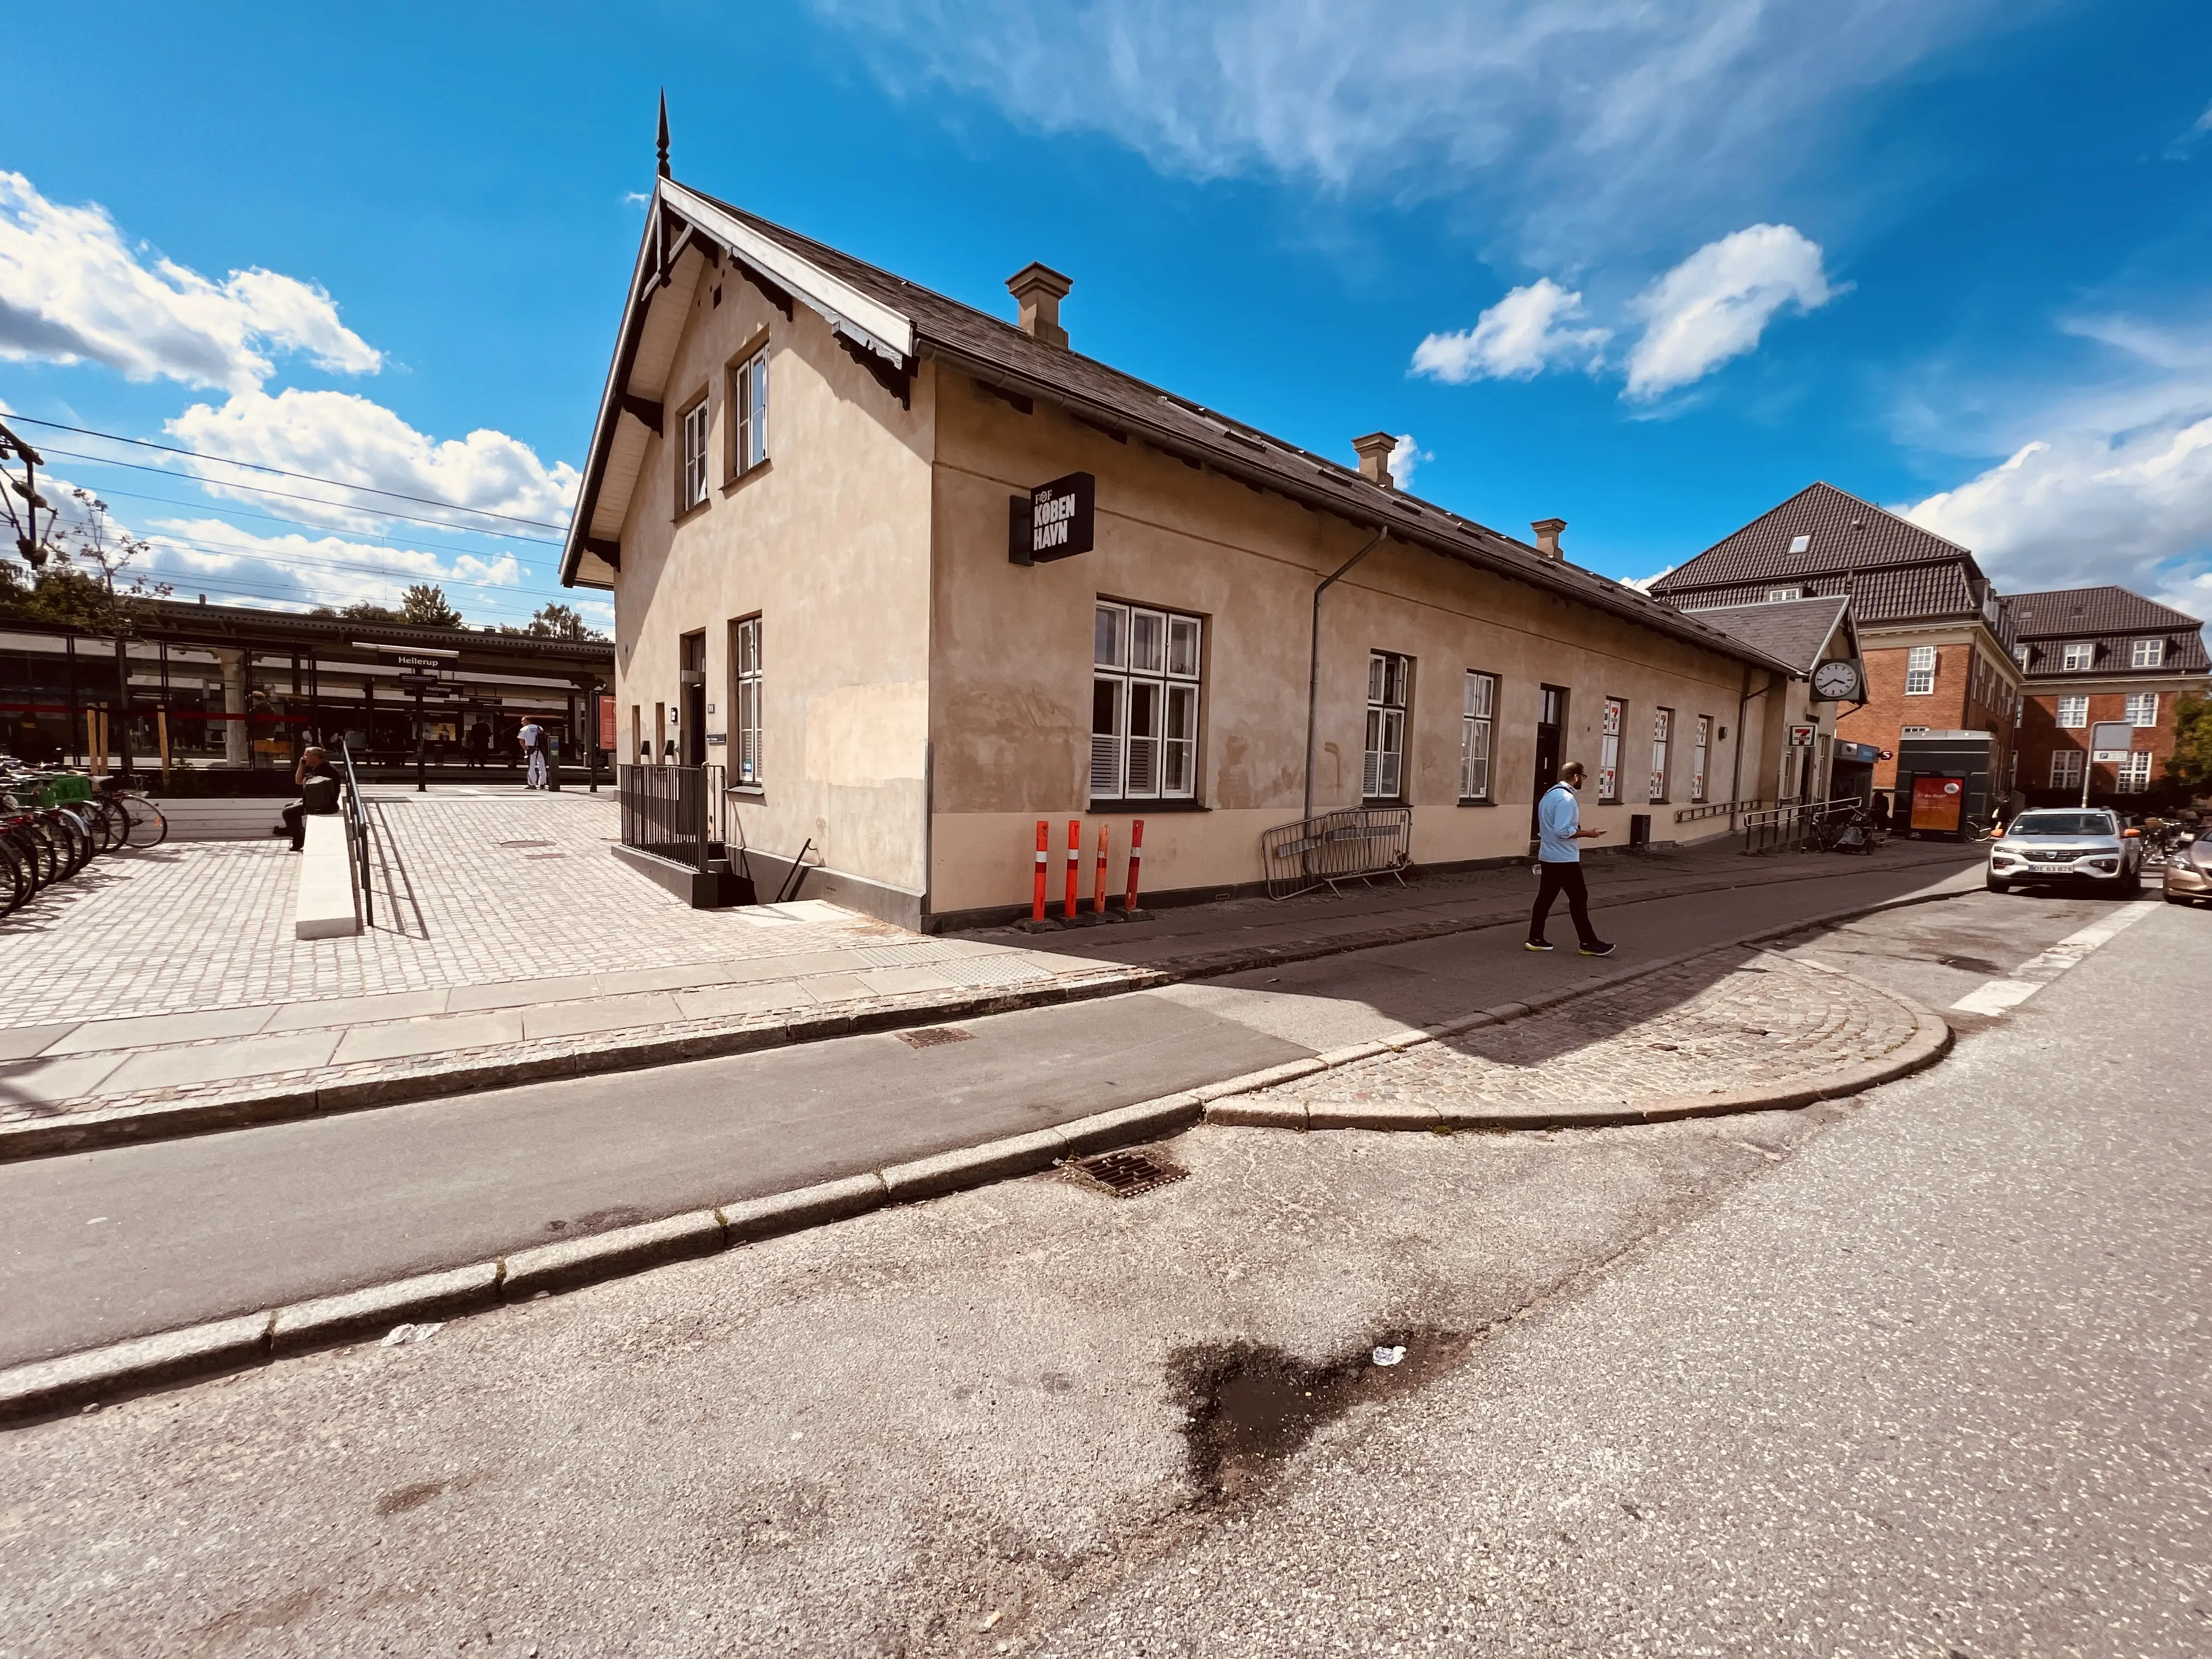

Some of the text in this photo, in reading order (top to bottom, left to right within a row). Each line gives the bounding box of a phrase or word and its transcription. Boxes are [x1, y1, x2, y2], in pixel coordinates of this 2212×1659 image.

[1034, 493, 1075, 528] KØBEN
[1034, 520, 1068, 551] HAVN
[398, 656, 438, 667] Hellerup
[1795, 729, 1810, 745] 7
